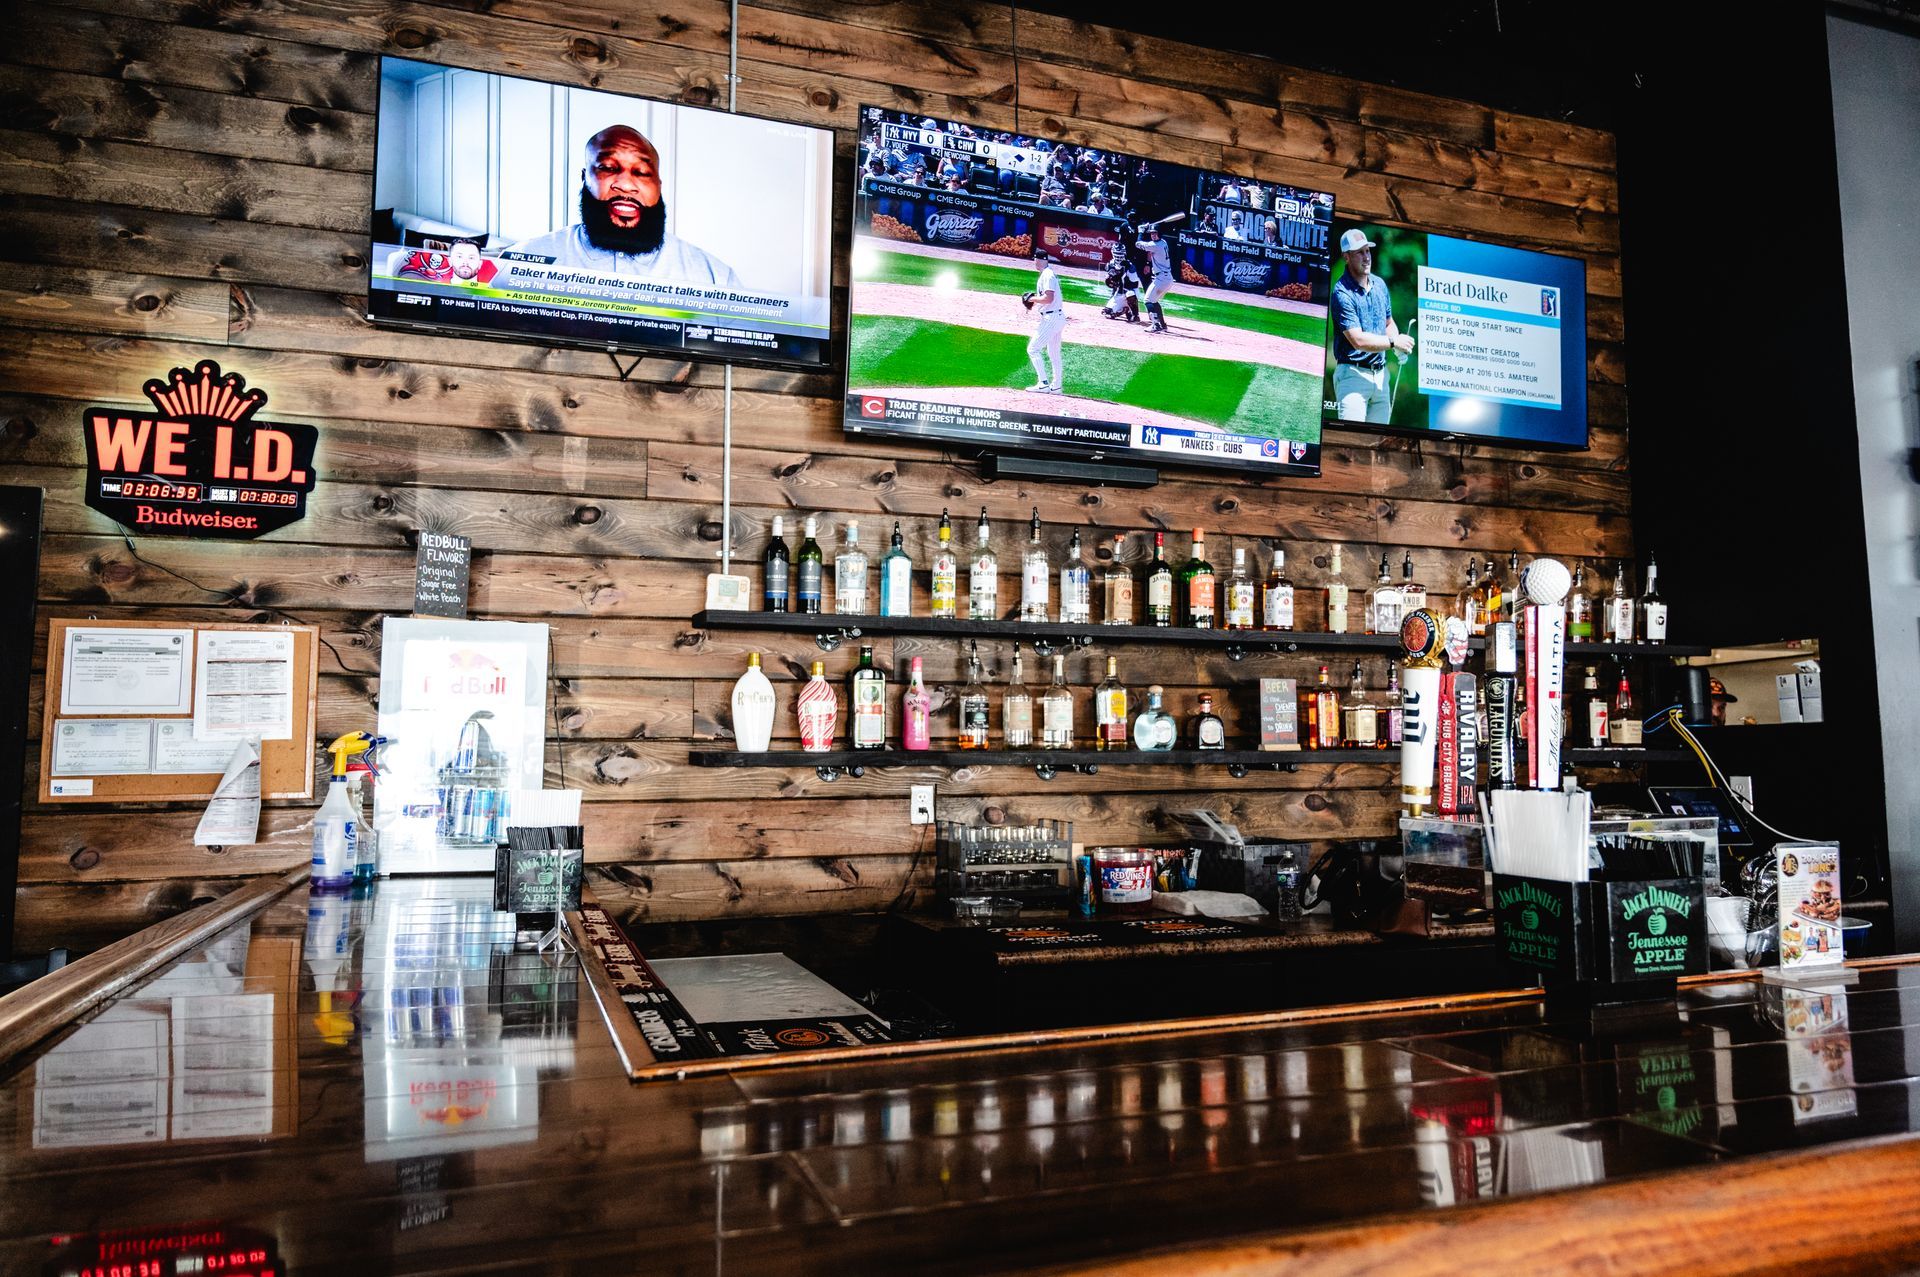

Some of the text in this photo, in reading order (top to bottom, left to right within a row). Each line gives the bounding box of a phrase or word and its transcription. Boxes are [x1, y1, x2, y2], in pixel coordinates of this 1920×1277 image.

[902, 129, 918, 141] NYY
[891, 142, 909, 151] VOLPE
[957, 140, 975, 151] CHW
[944, 151, 971, 162] NEWCOMB
[878, 184, 921, 199] CME Group
[936, 195, 978, 208] CME Group
[1279, 201, 1295, 211] YES
[998, 206, 1035, 218] CME Group
[925, 213, 984, 243] Garrett
[1288, 216, 1314, 225] SEASON
[1179, 233, 1216, 249] Rate Field
[1222, 241, 1259, 255] Rate Field
[510, 253, 545, 263] NFL LIVE
[1265, 249, 1301, 263] Rate Field
[1224, 261, 1271, 284] Garrett
[510, 266, 789, 308] Baker Mayfield ends contract talks with Buccaneers
[1425, 277, 1508, 304] Brad Dalke
[397, 294, 432, 306] ESPN
[508, 278, 783, 317] Says he was offered 2-year deal; wants long-term commitment
[512, 292, 523, 300] As
[524, 292, 537, 301] told
[552, 296, 579, 306] ESPN's
[581, 298, 611, 310] Jeremy
[610, 303, 637, 312] Fowler
[441, 298, 456, 306] TOP
[458, 300, 475, 308] NEWS
[481, 302, 500, 311] UEFA
[502, 304, 510, 312] to
[511, 305, 538, 318] boycott
[539, 307, 560, 318] World
[578, 312, 593, 321] FIFA
[594, 315, 617, 326] comps
[618, 318, 633, 326] over
[635, 319, 658, 331] private
[659, 321, 681, 332] equity
[1425, 301, 1461, 313] CAREER BIO
[1425, 314, 1523, 334] FIRST PGA TOUR START SINCE
[1425, 324, 1475, 337] 2017 U.S. OPEN
[1426, 340, 1520, 358] YOUTUBE CONTENT CREATOR
[1433, 349, 1536, 368] MILLION SUBSCRIBERS (GOOD GOOD GOLF)
[1425, 362, 1538, 383] RUNNER-UP AT 2016 U.S. AMATEUR
[1426, 378, 1440, 386] 2017
[1441, 379, 1459, 388] NCAA
[1460, 381, 1492, 392] NATIONAL
[1493, 386, 1527, 397] CHAMPION
[889, 400, 1001, 419] TRADE DEADLINE RUMORS
[918, 412, 1126, 441] INTEREST IN HUNTER GREENE, TEAM ISN'T PARTICULARLY
[93, 417, 305, 484] WE I.D.
[1181, 438, 1243, 454] YANKEES CUBS
[1292, 442, 1307, 450] LIVE
[103, 483, 121, 493] TIME
[427, 549, 464, 564] FLAVORS
[422, 565, 456, 580] Original
[421, 579, 457, 591] Sugar Free
[419, 591, 460, 603] White Peach
[1403, 597, 1420, 605] KNOB
[1416, 611, 1435, 631] PILSNER
[1265, 681, 1288, 693] BEER
[1459, 690, 1475, 781] RIVALRY
[1489, 702, 1502, 778] LAGUNITAS
[1549, 704, 1560, 772] Michelob
[1441, 720, 1452, 809] HUB CITY BREWING
[1460, 786, 1474, 804] IPA
[517, 851, 576, 874] JACK DANEL'S
[1801, 853, 1837, 864] 20% OFF
[1110, 871, 1145, 880] RED VINES
[520, 882, 570, 893] Tennesee
[1499, 881, 1562, 917] JACK DANIEL'S
[1622, 886, 1691, 920] JACK DANIEL'S
[1504, 922, 1560, 945] Tennessee
[1628, 932, 1688, 949] Tennessee
[1508, 942, 1557, 960] APPLE
[1633, 949, 1685, 965] APPLE
